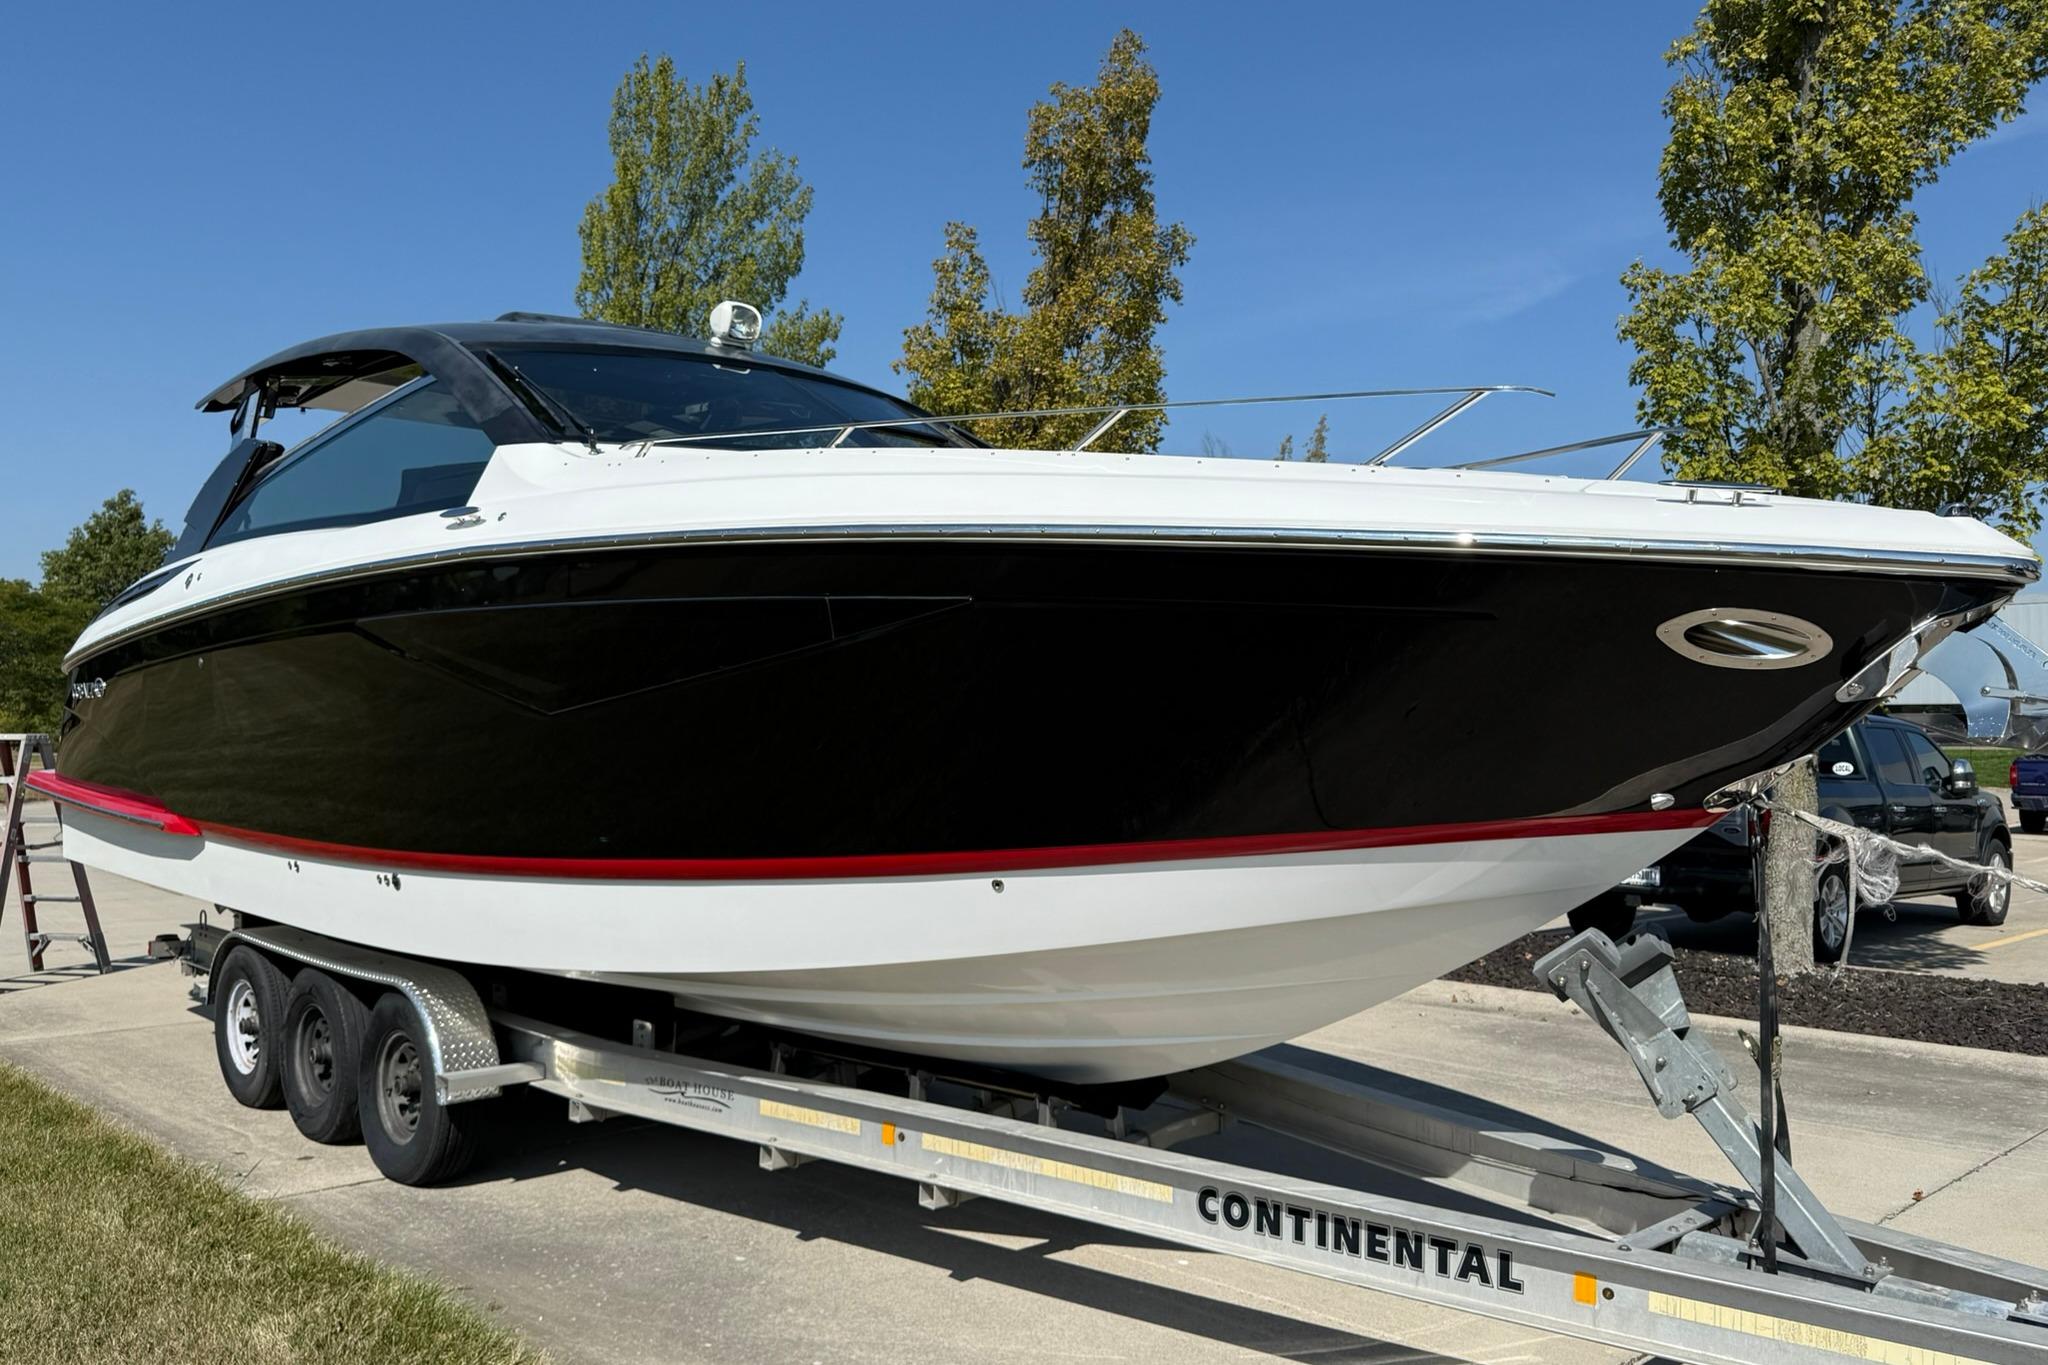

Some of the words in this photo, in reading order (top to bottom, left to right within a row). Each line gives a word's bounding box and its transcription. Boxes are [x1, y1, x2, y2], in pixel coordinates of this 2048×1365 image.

[1835, 764, 1851, 773] LOCAL
[659, 1076, 691, 1092] BOAT
[693, 1082, 735, 1101] HOUSE
[1197, 1185, 1524, 1294] CONTINENTAL
